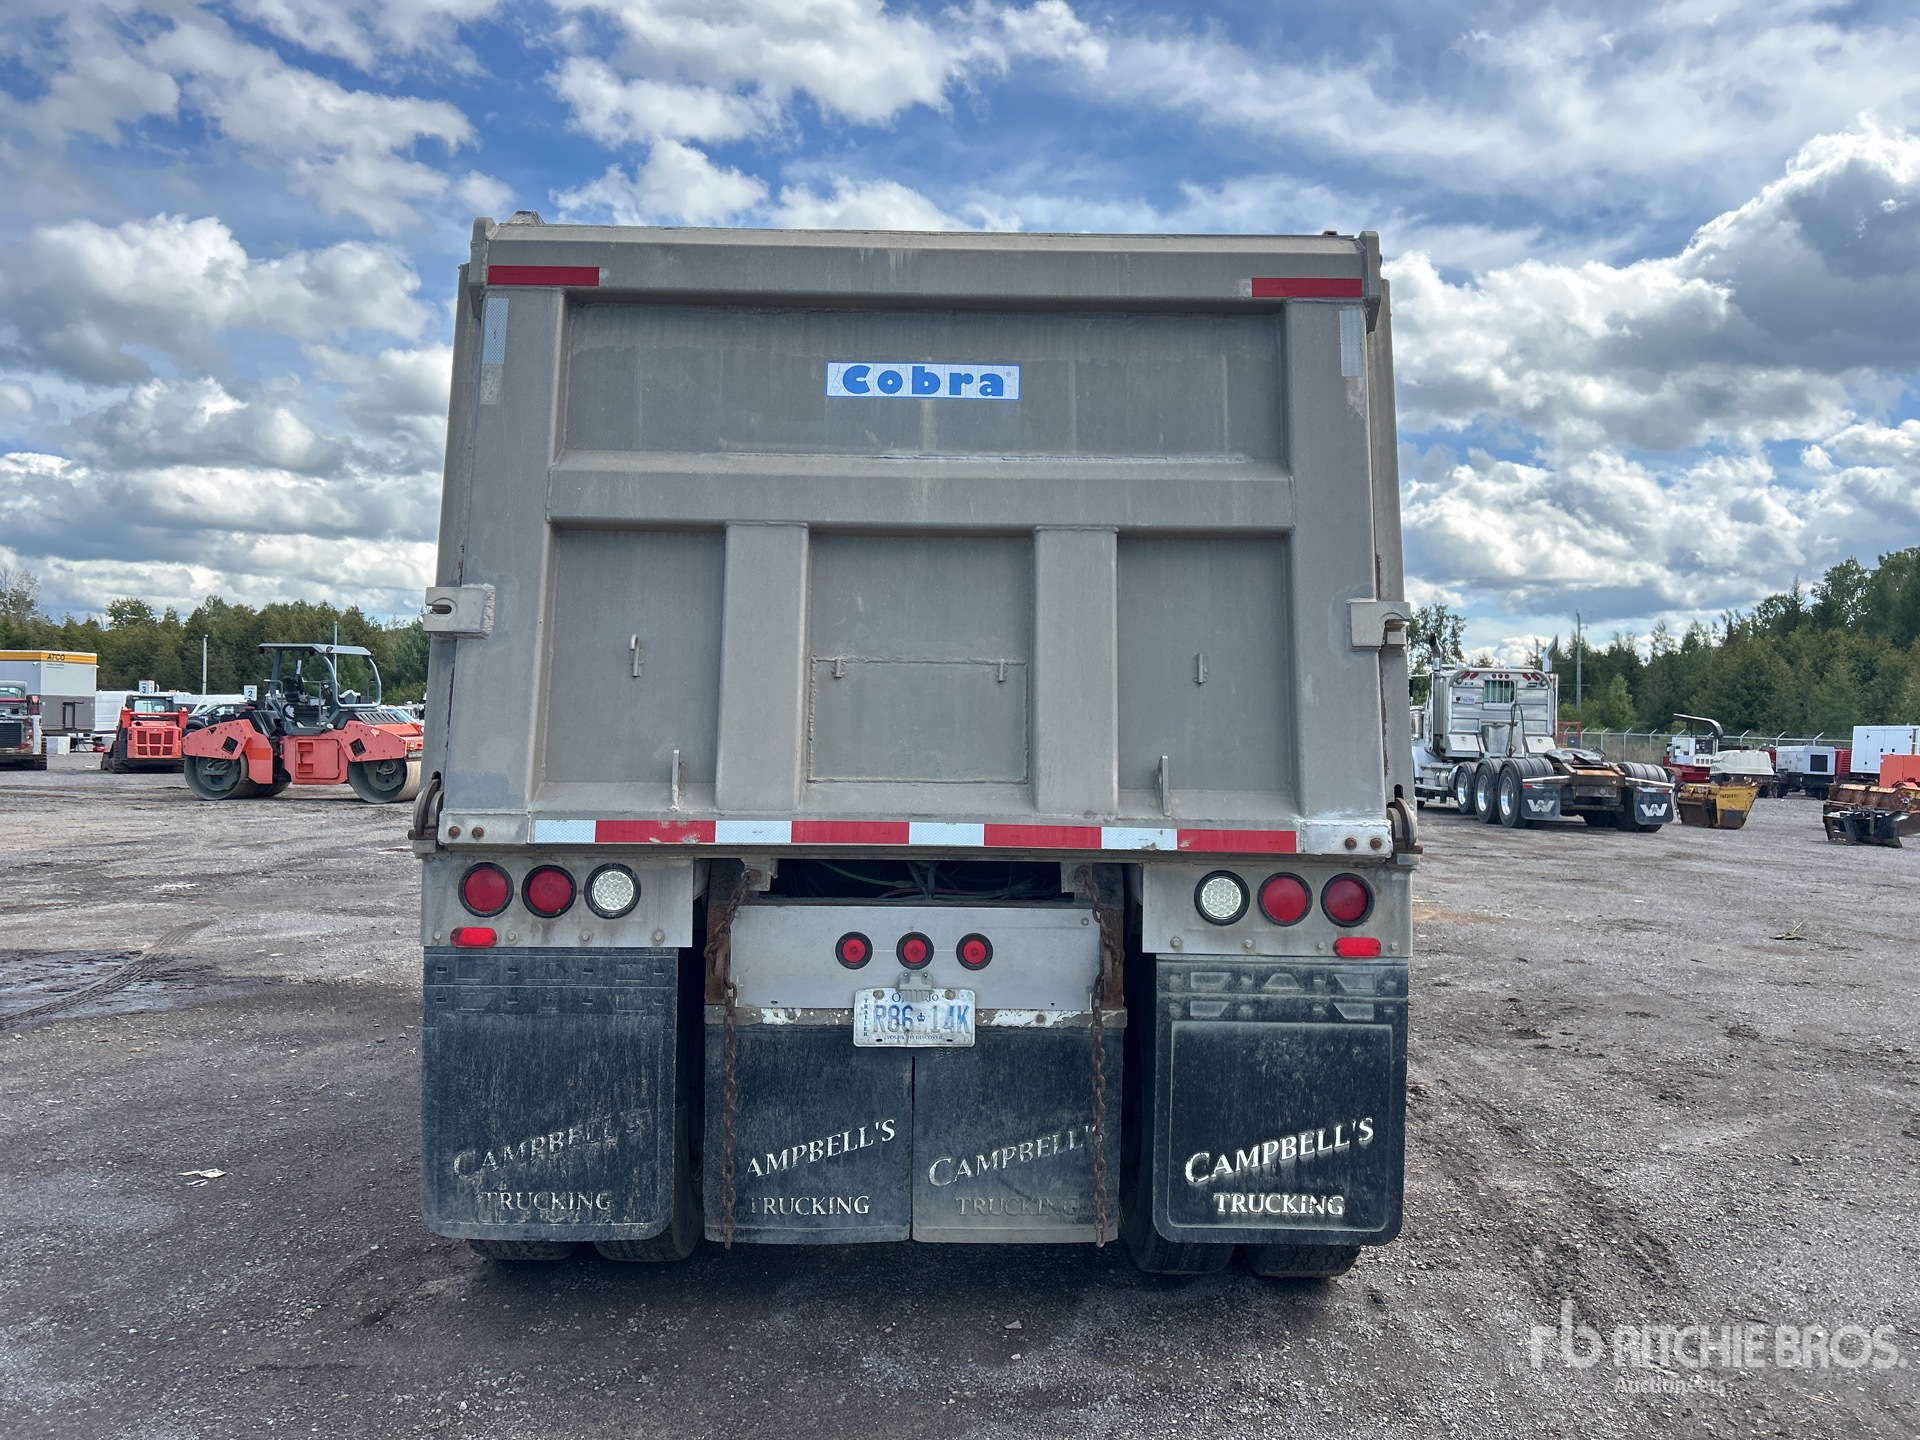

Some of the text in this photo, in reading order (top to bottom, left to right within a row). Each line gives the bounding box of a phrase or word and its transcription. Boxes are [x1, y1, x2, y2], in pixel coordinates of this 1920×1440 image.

[842, 365, 1004, 397] Cobra
[47, 653, 66, 661] ATCO
[873, 1004, 970, 1033] R86 14K
[1185, 1117, 1374, 1184] CAMPBELL'S
[480, 1190, 613, 1211] TRUCKING
[955, 1197, 1080, 1217] TRUCKING
[1213, 1193, 1346, 1216] TRUCKING
